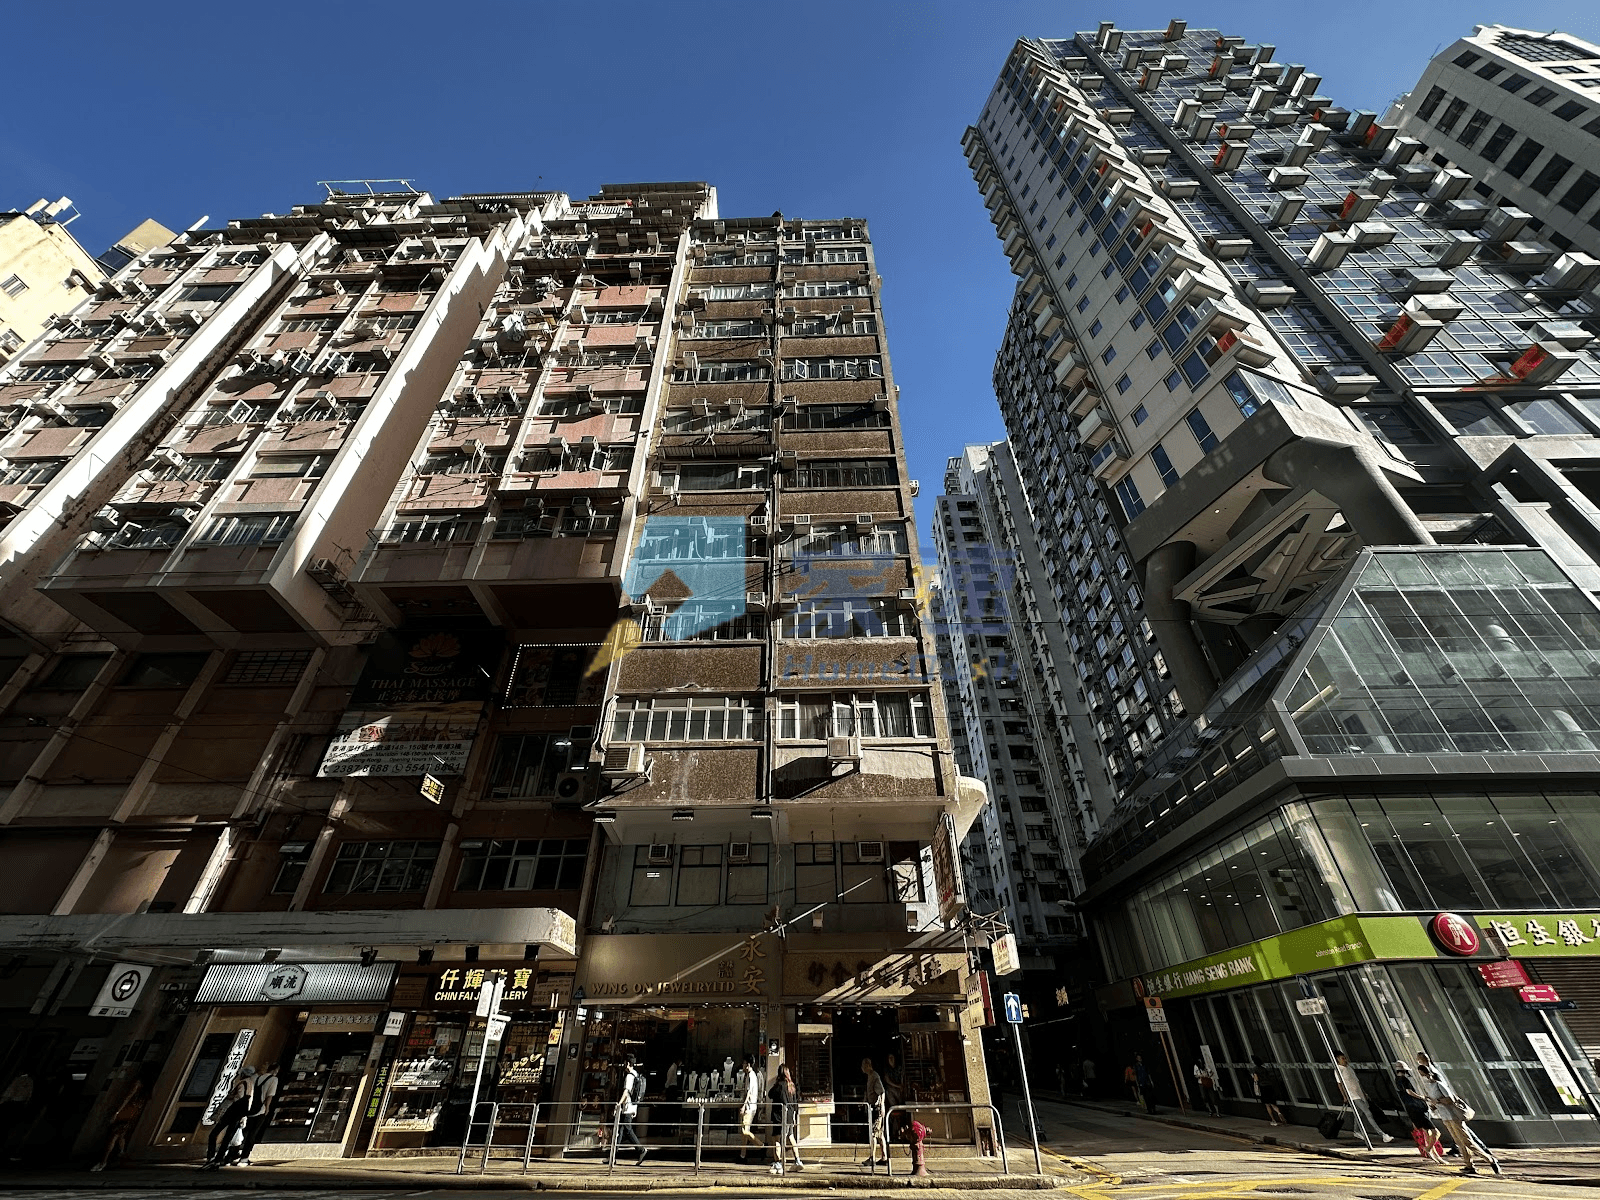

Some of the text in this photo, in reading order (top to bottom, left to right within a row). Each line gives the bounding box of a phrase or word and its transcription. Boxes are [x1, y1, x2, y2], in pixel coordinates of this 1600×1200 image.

[370, 677, 477, 689] THAI MASSAGE
[333, 764, 362, 773] 2387
[363, 764, 389, 773] 8688
[405, 763, 432, 772] 5547
[738, 937, 767, 995] 永安
[1182, 955, 1257, 986] HANG SENG BANK
[591, 982, 629, 995] WING
[633, 982, 653, 995] ON
[1146, 971, 1183, 995] 恒生銀行
[434, 991, 458, 1001] CHIN
[458, 991, 473, 1001] FAI
